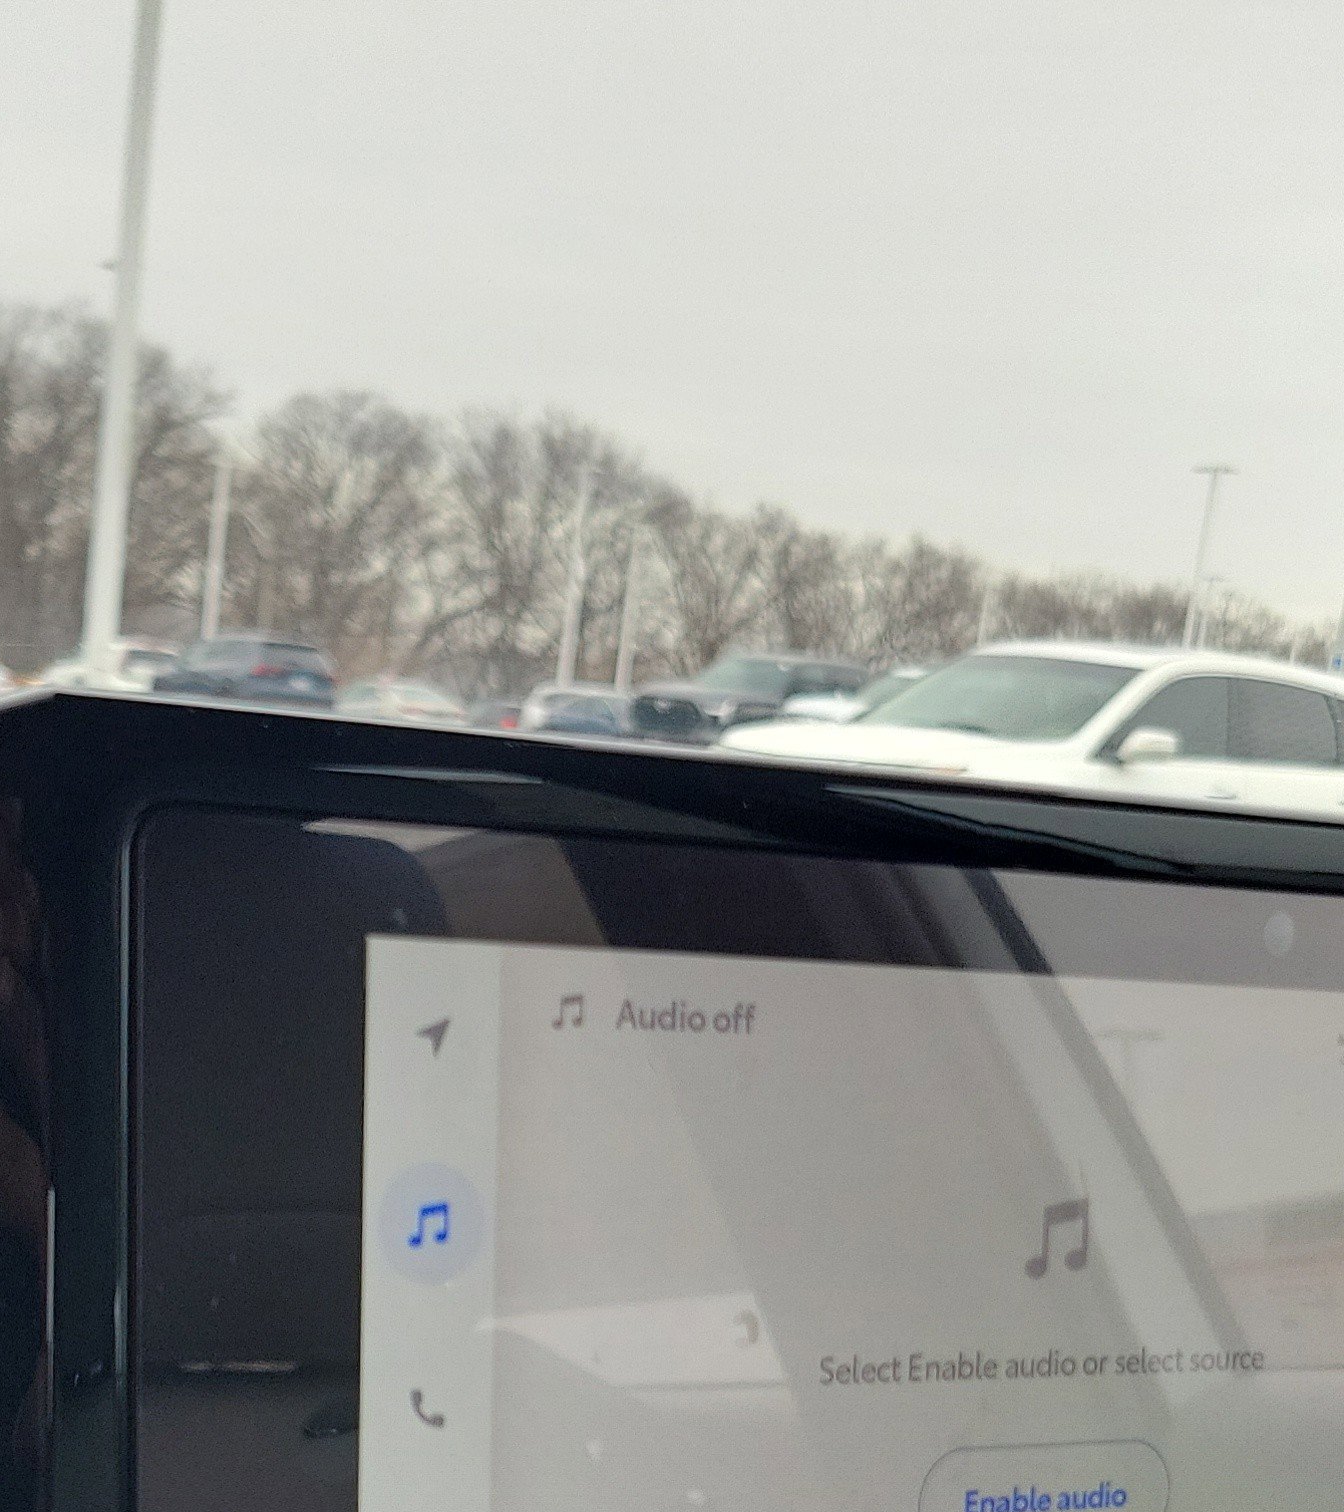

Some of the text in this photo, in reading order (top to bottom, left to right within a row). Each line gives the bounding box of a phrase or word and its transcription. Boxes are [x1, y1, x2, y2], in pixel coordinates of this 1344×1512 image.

[615, 999, 756, 1034] Audio off
[819, 1347, 1265, 1386] Select Enable audio or select source
[1056, 1481, 1128, 1512] audio
